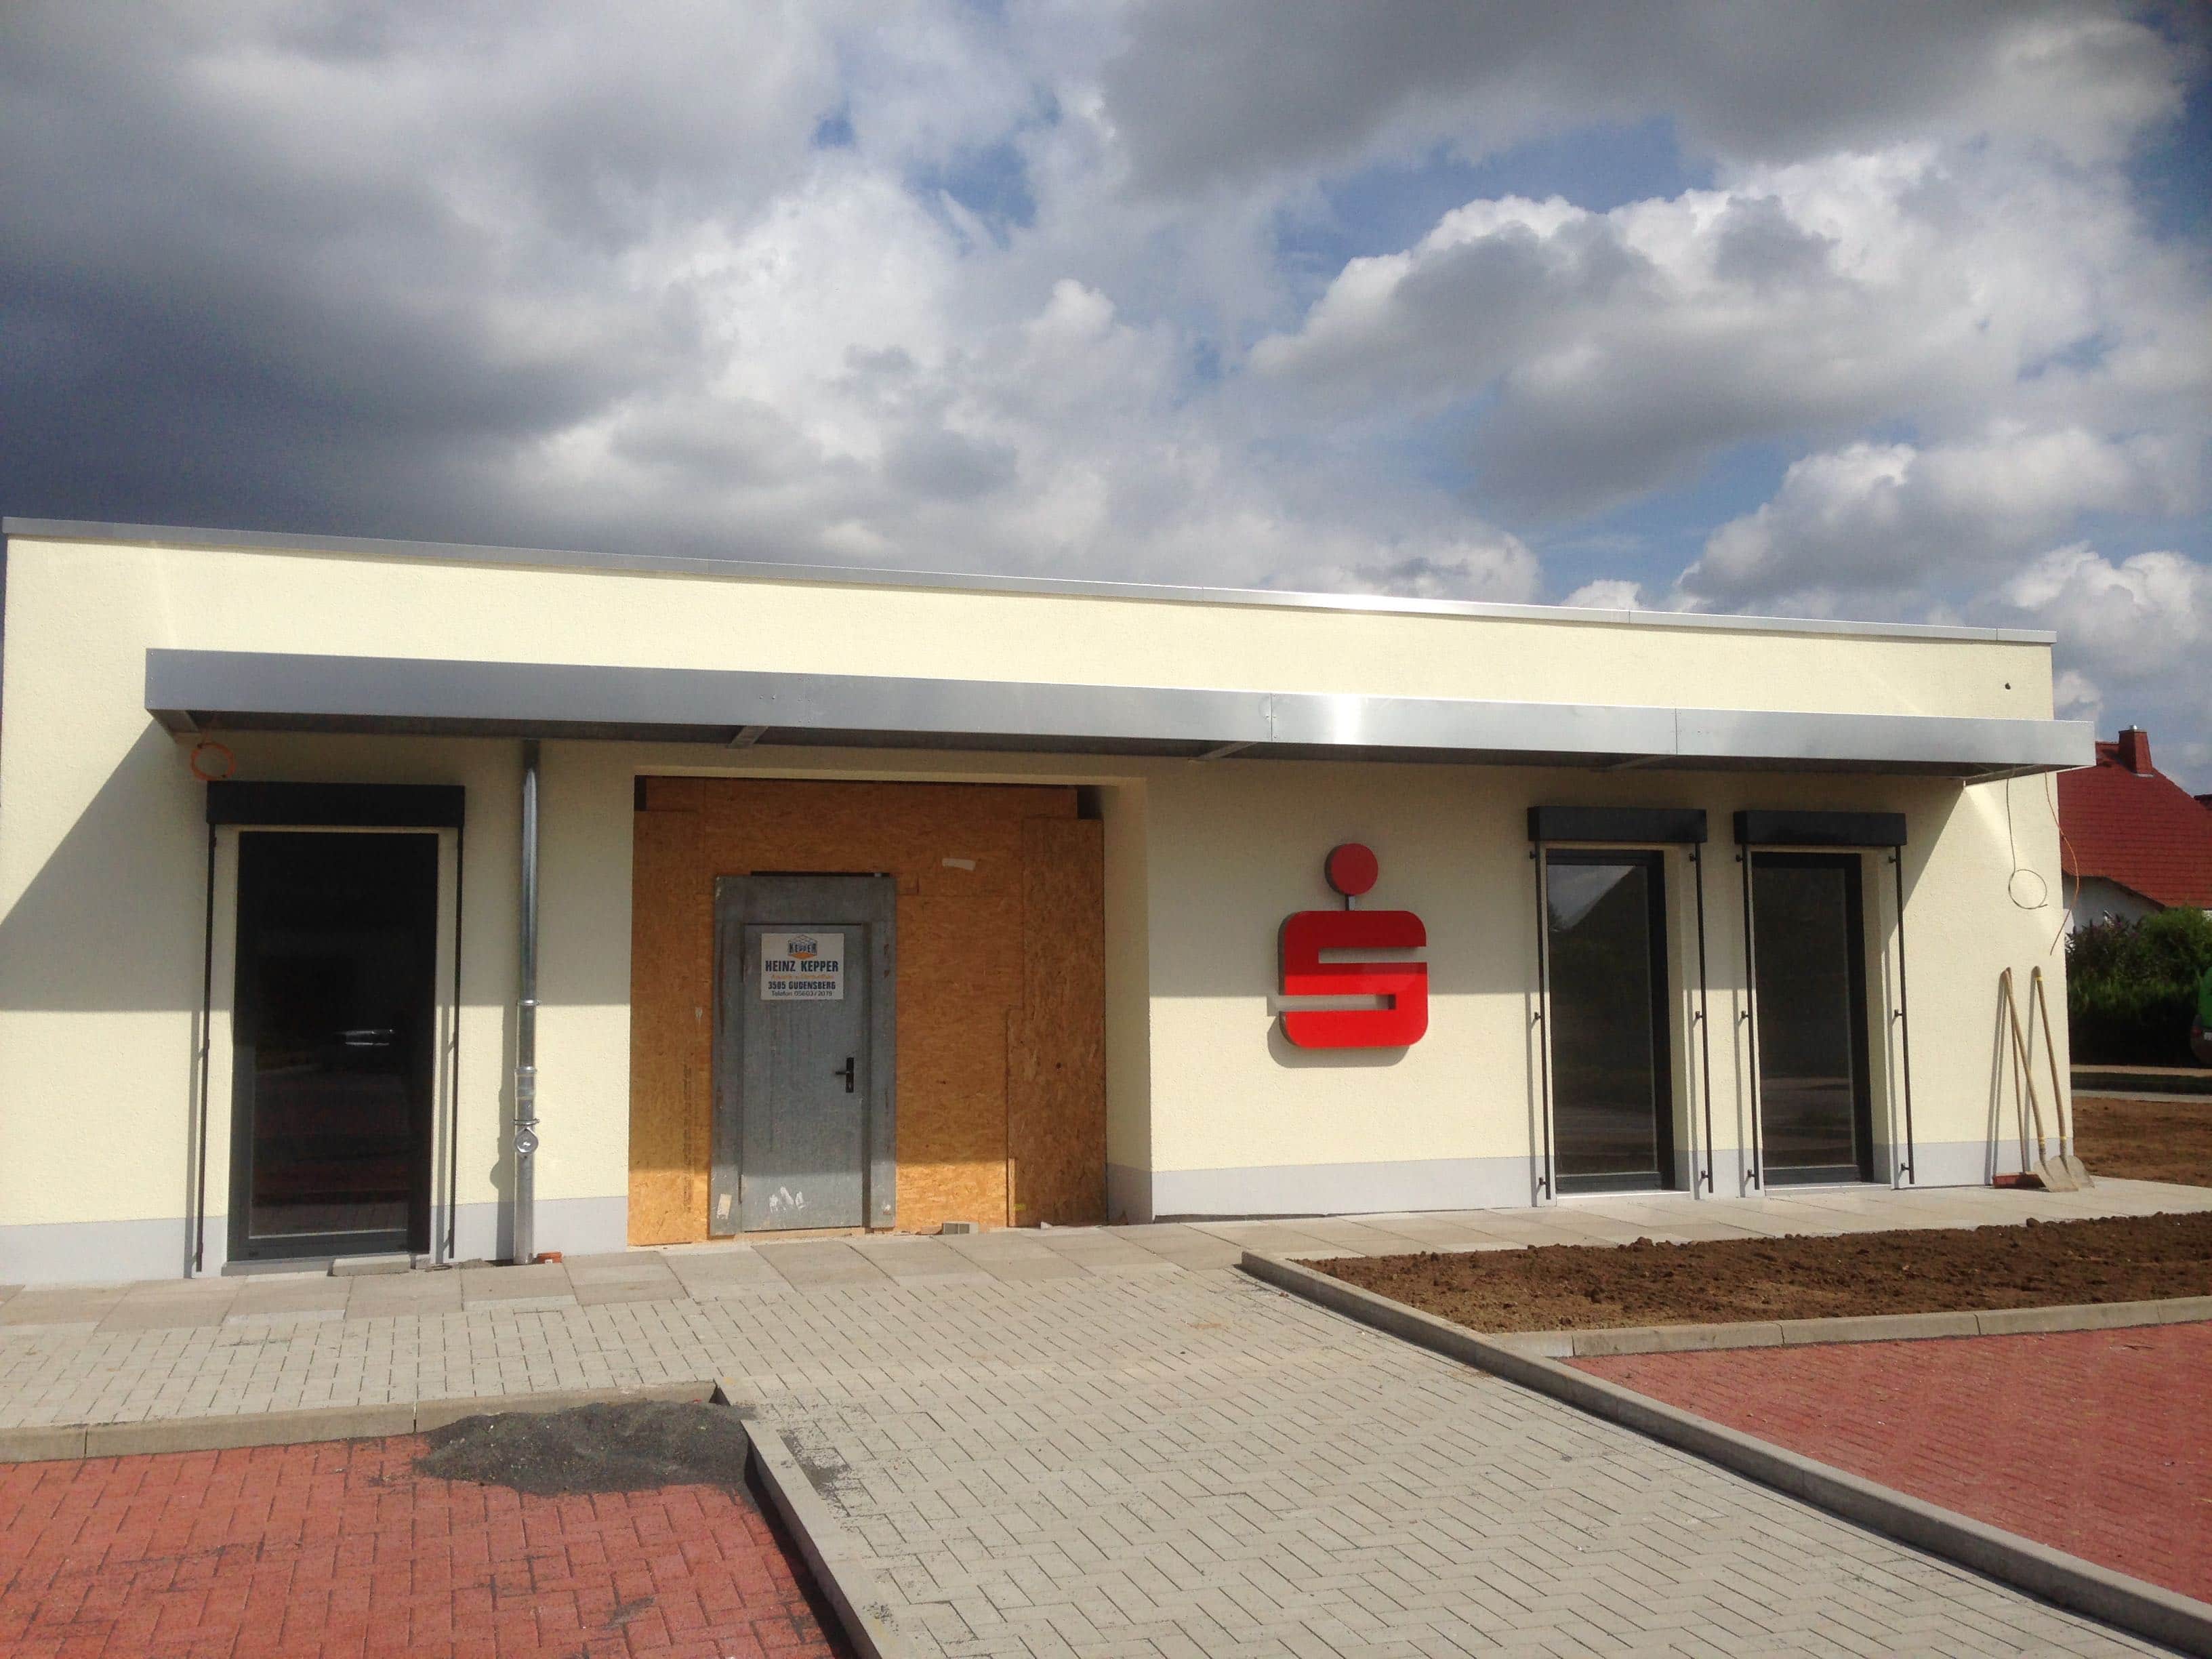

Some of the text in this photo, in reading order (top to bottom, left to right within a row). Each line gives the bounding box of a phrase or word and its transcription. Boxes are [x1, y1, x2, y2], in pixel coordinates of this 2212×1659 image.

[765, 960, 838, 972] HEINZ KEPPER
[768, 981, 836, 989] 3505 GUDENSBERG
